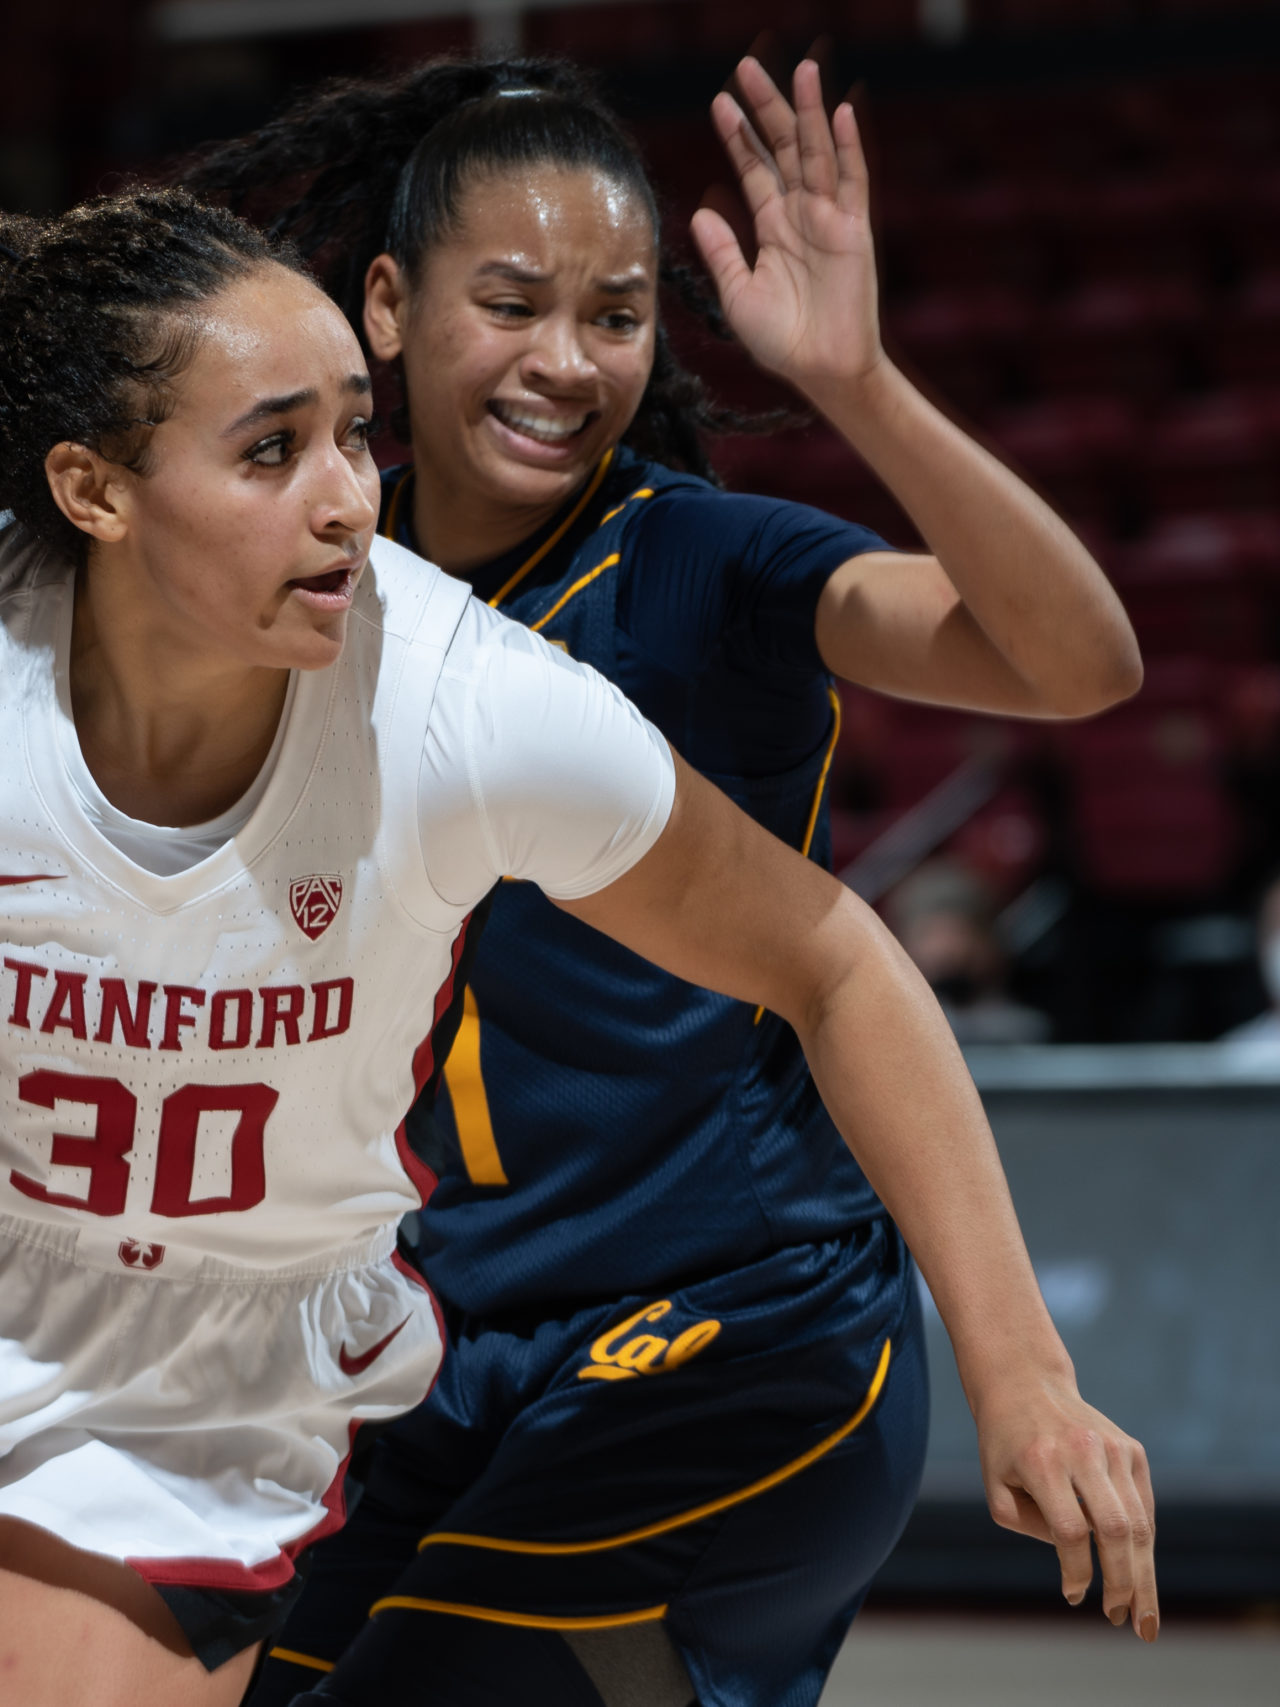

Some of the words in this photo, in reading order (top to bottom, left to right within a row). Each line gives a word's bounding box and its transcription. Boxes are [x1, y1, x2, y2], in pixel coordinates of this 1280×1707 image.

[291, 878, 341, 918] PAC
[303, 903, 329, 929] 12
[9, 1068, 280, 1218] 30
[577, 1299, 721, 1380] Cal
